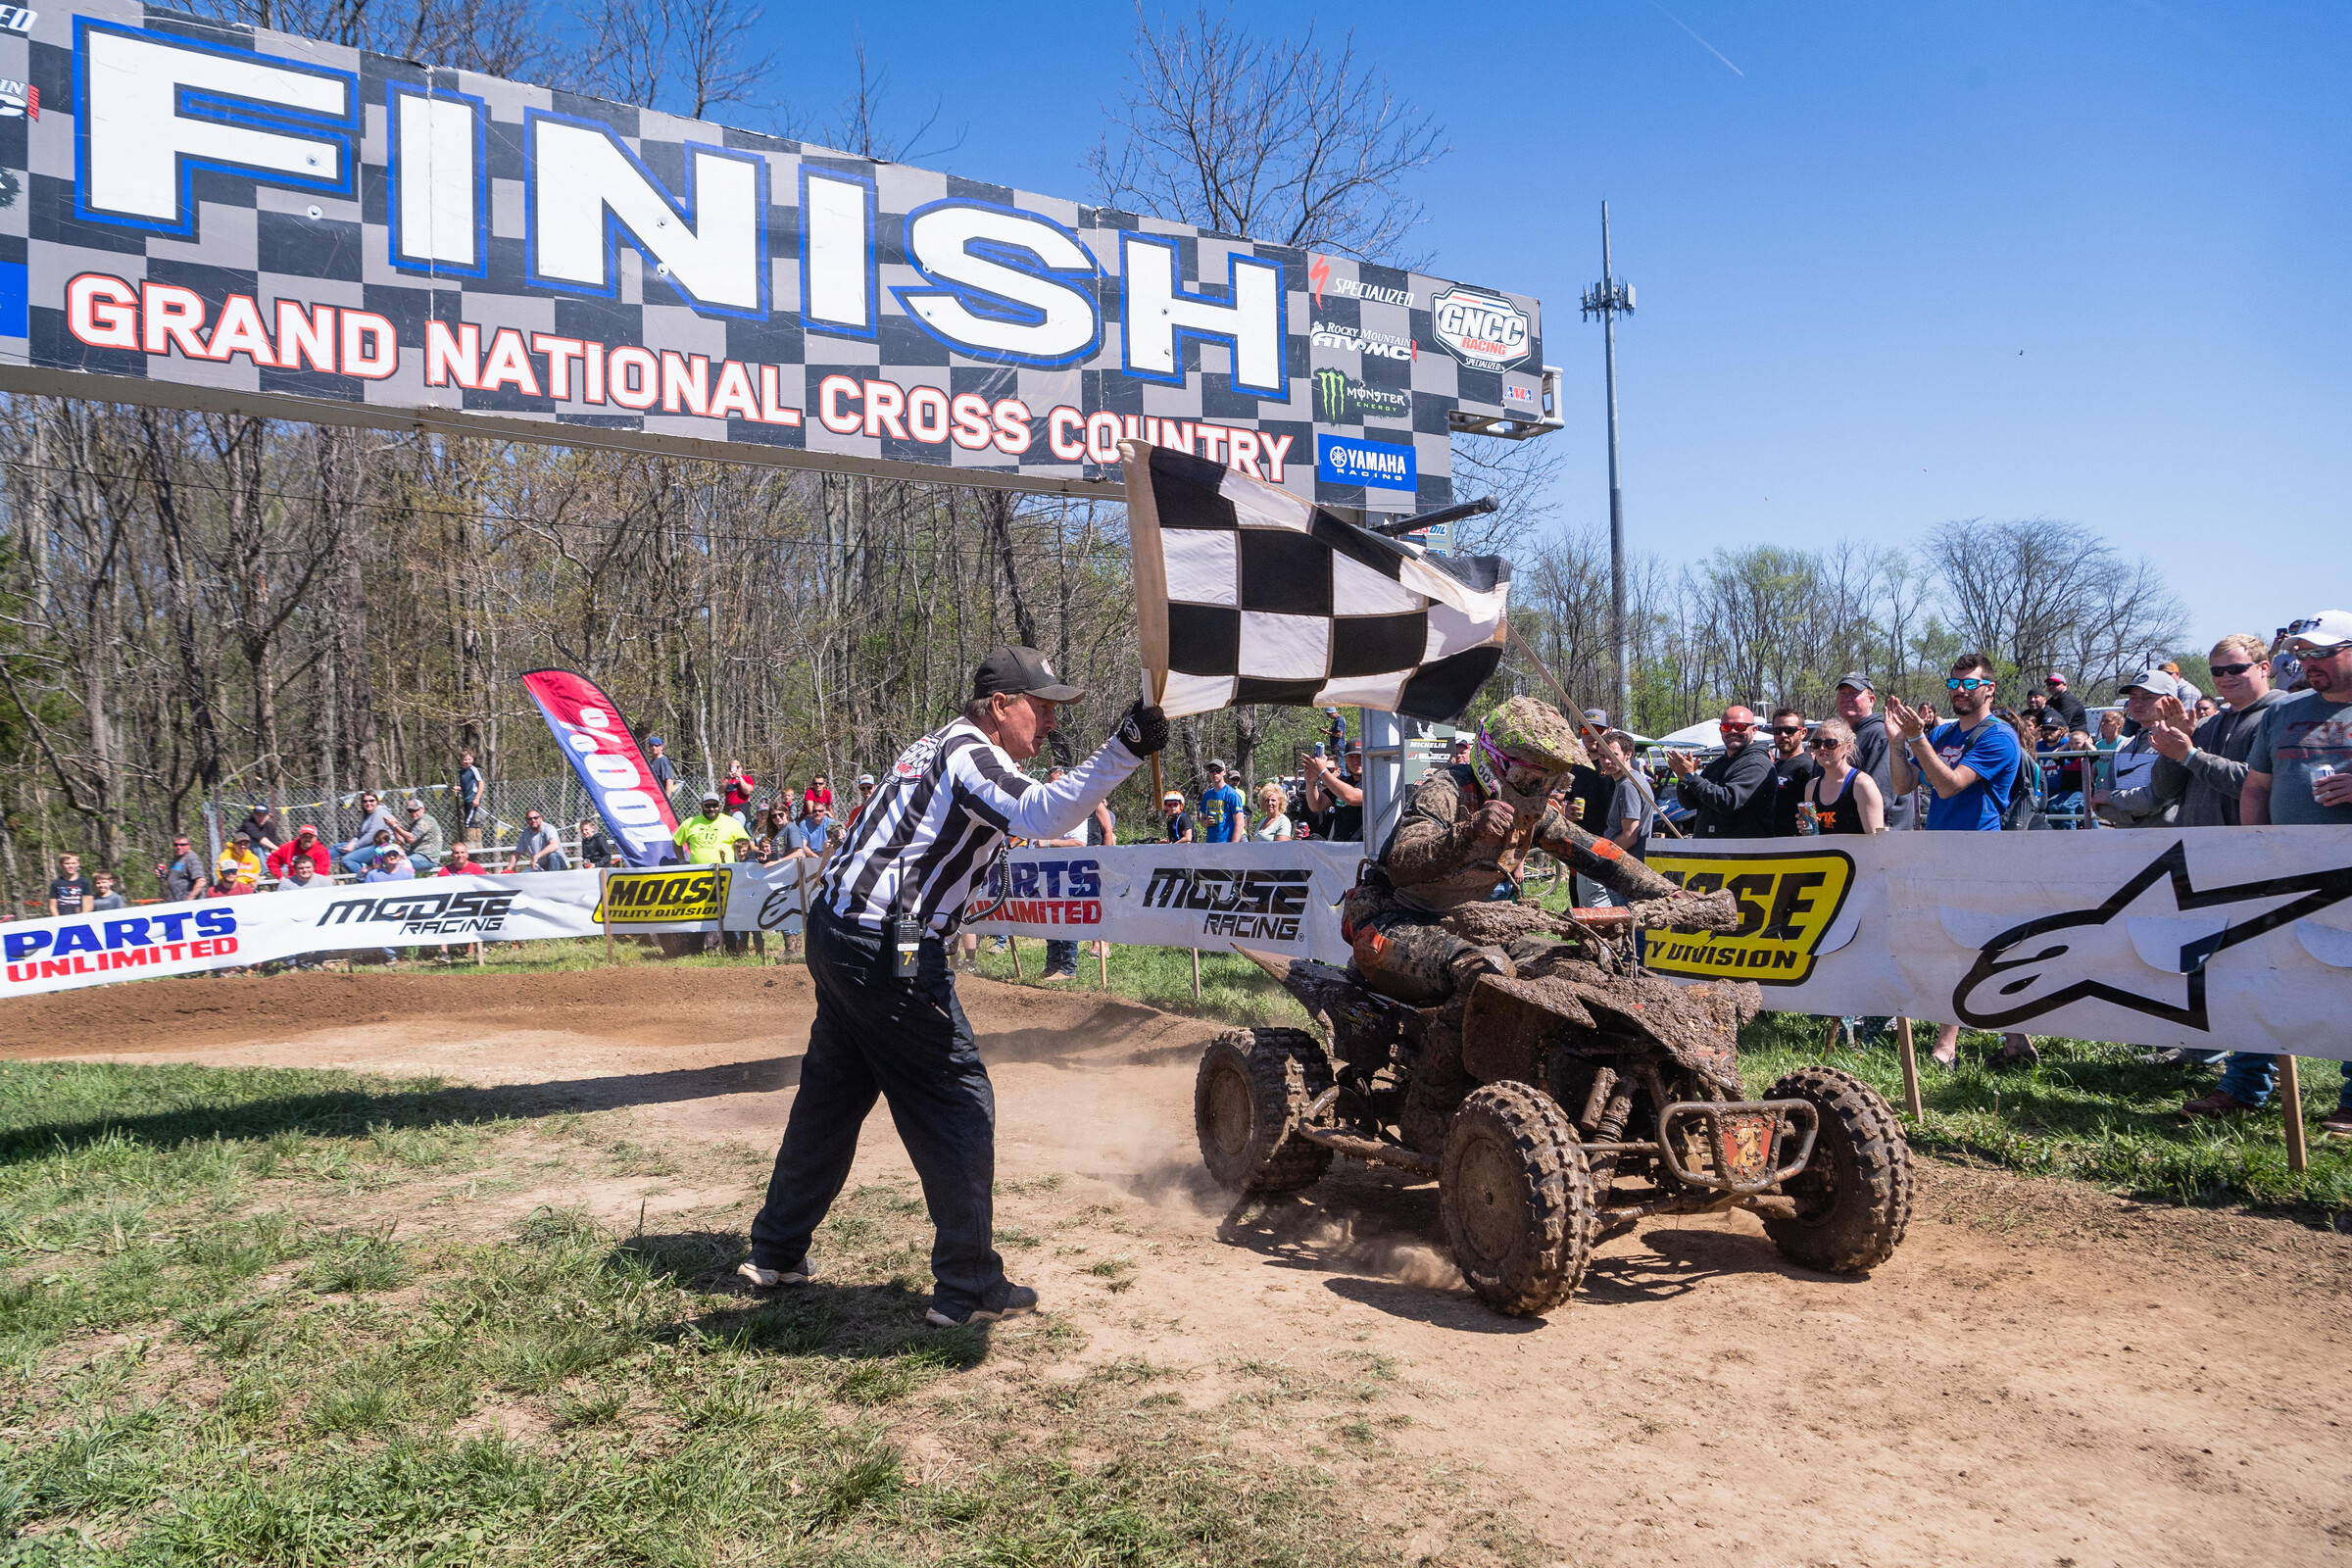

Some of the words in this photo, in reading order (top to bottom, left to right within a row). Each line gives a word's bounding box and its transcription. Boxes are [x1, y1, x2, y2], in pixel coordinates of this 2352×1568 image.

[73, 15, 1288, 401] FINISH
[1333, 277, 1415, 307] SPECIALIZED
[1326, 321, 1359, 337] ROCKY
[1359, 328, 1411, 347] MOUNTAIN
[1439, 303, 1525, 346] GNCC
[1461, 336, 1507, 356] RACING
[67, 272, 397, 380] GRAND
[425, 319, 801, 426] NATIONAL
[819, 374, 1033, 455] CROSS
[1050, 405, 1295, 483] COUNTRY
[1465, 357, 1501, 371] SPECIALIZED
[1347, 386, 1405, 406] MONSTER
[1356, 401, 1397, 412] ENERGY
[1504, 385, 1533, 401] AMA
[1337, 467, 1402, 481] RACING
[1347, 448, 1406, 475] YAMAHA
[568, 708, 673, 853] 100%
[608, 876, 727, 906] MOOSE
[980, 859, 1102, 899] ARTS
[1142, 867, 1313, 915] MOOSE
[316, 889, 523, 927] MOOSE
[969, 900, 1102, 924] UNLIMITED
[4, 907, 237, 962] PARTS
[399, 916, 506, 936] RACING
[1203, 913, 1301, 941] RACING
[7, 936, 238, 983] UNLIMITED
[1667, 944, 1798, 969] DIVISION
